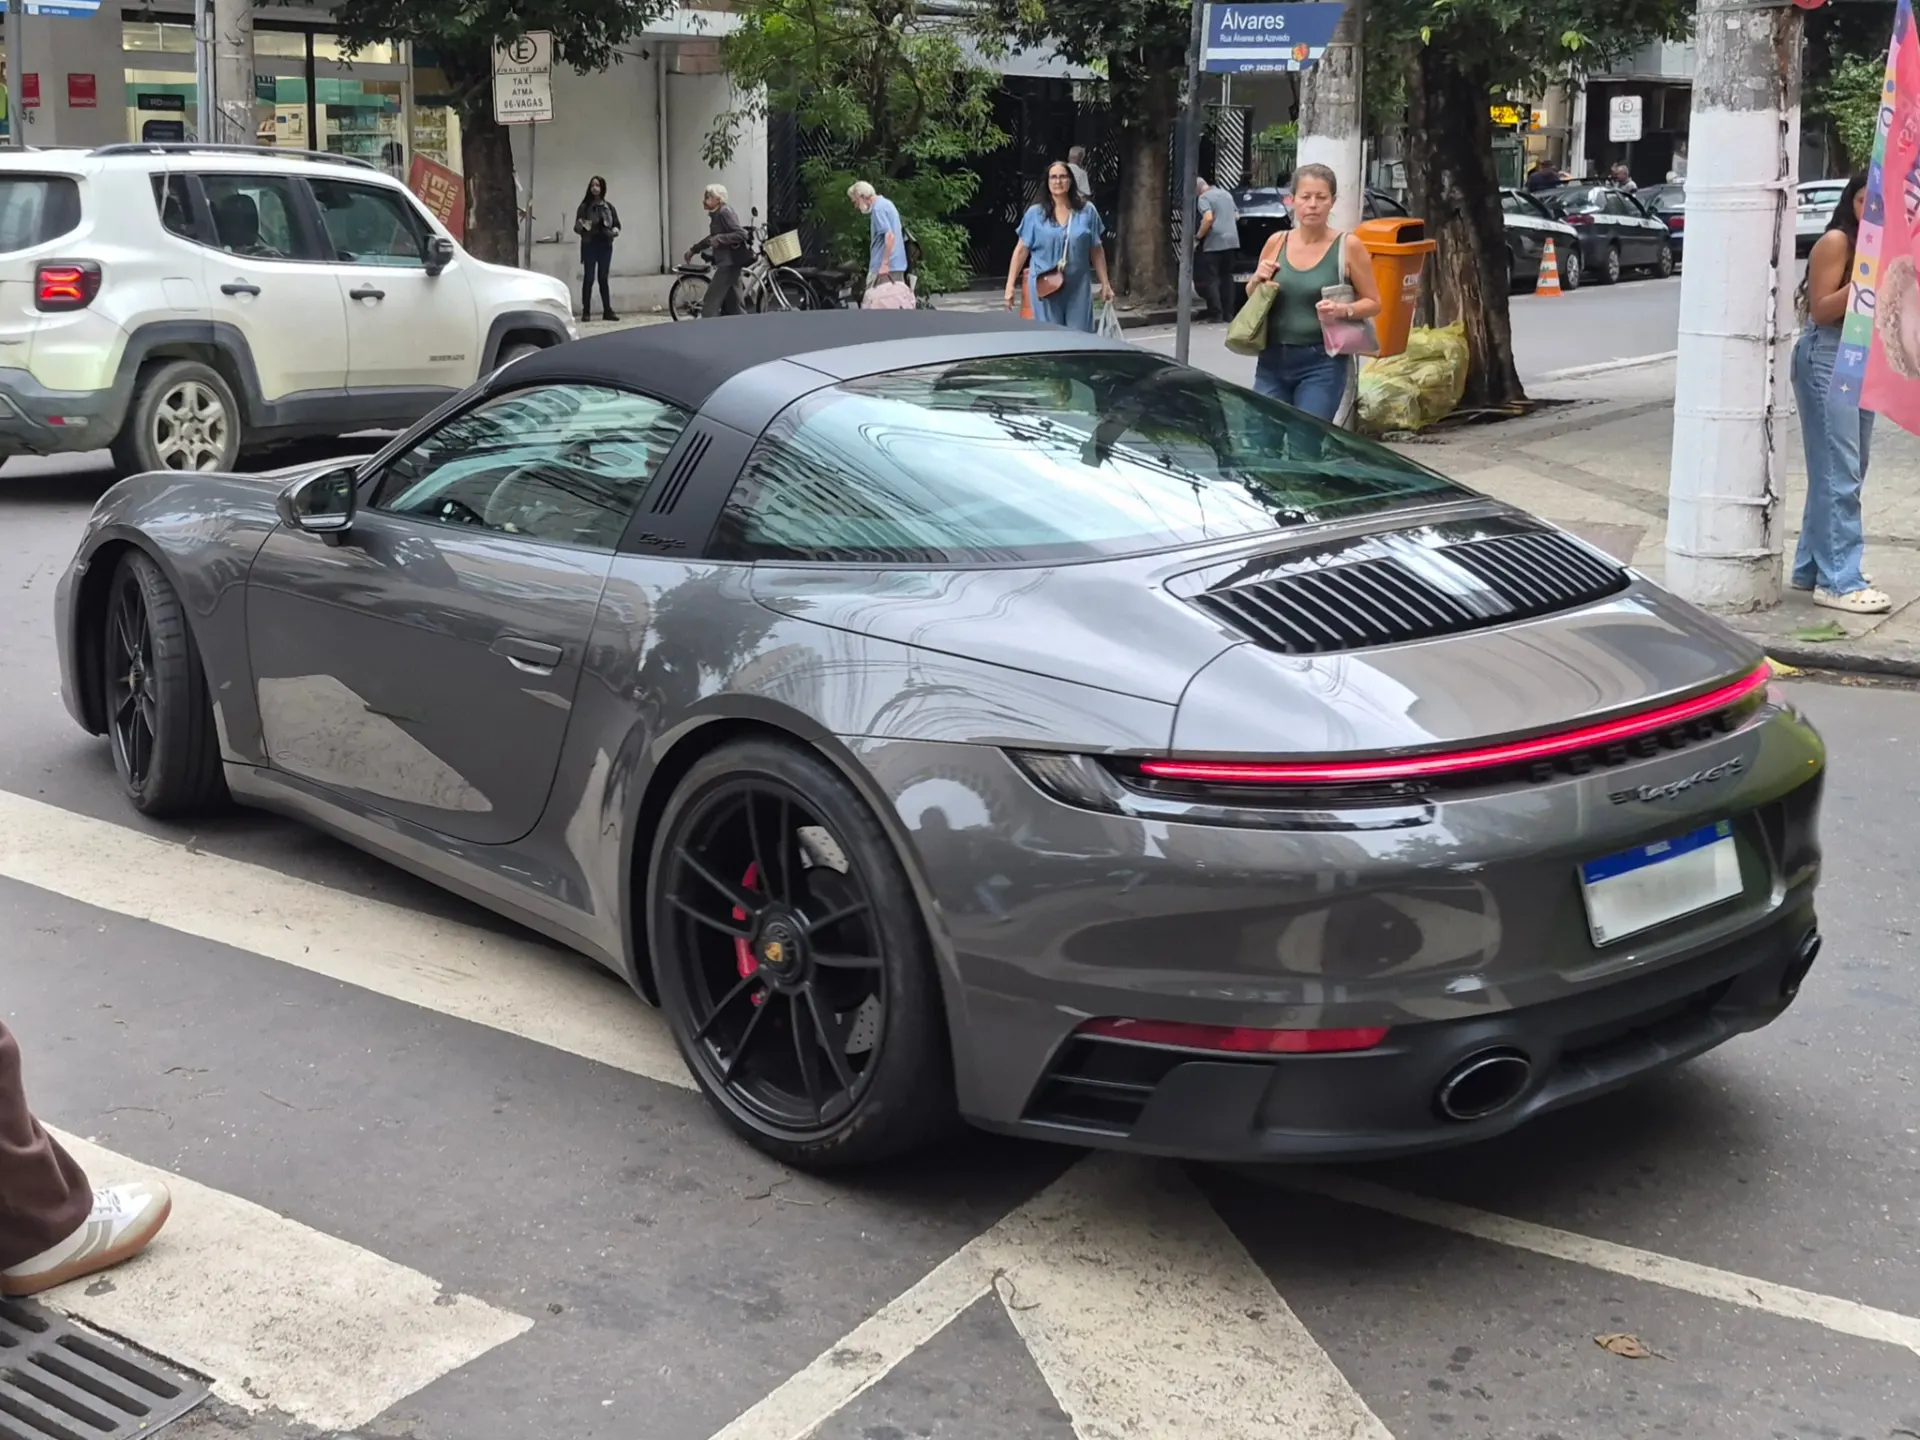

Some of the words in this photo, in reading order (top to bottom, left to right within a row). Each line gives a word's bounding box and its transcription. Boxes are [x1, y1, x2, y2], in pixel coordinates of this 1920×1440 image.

[1220, 8, 1285, 30] Álvares
[1220, 33, 1232, 43] Rua
[1233, 32, 1255, 42] Álvares
[1255, 33, 1264, 42] de
[1265, 33, 1290, 43] Azevedo
[512, 88, 533, 96] ATMA
[504, 98, 544, 109] 06-VAGAS
